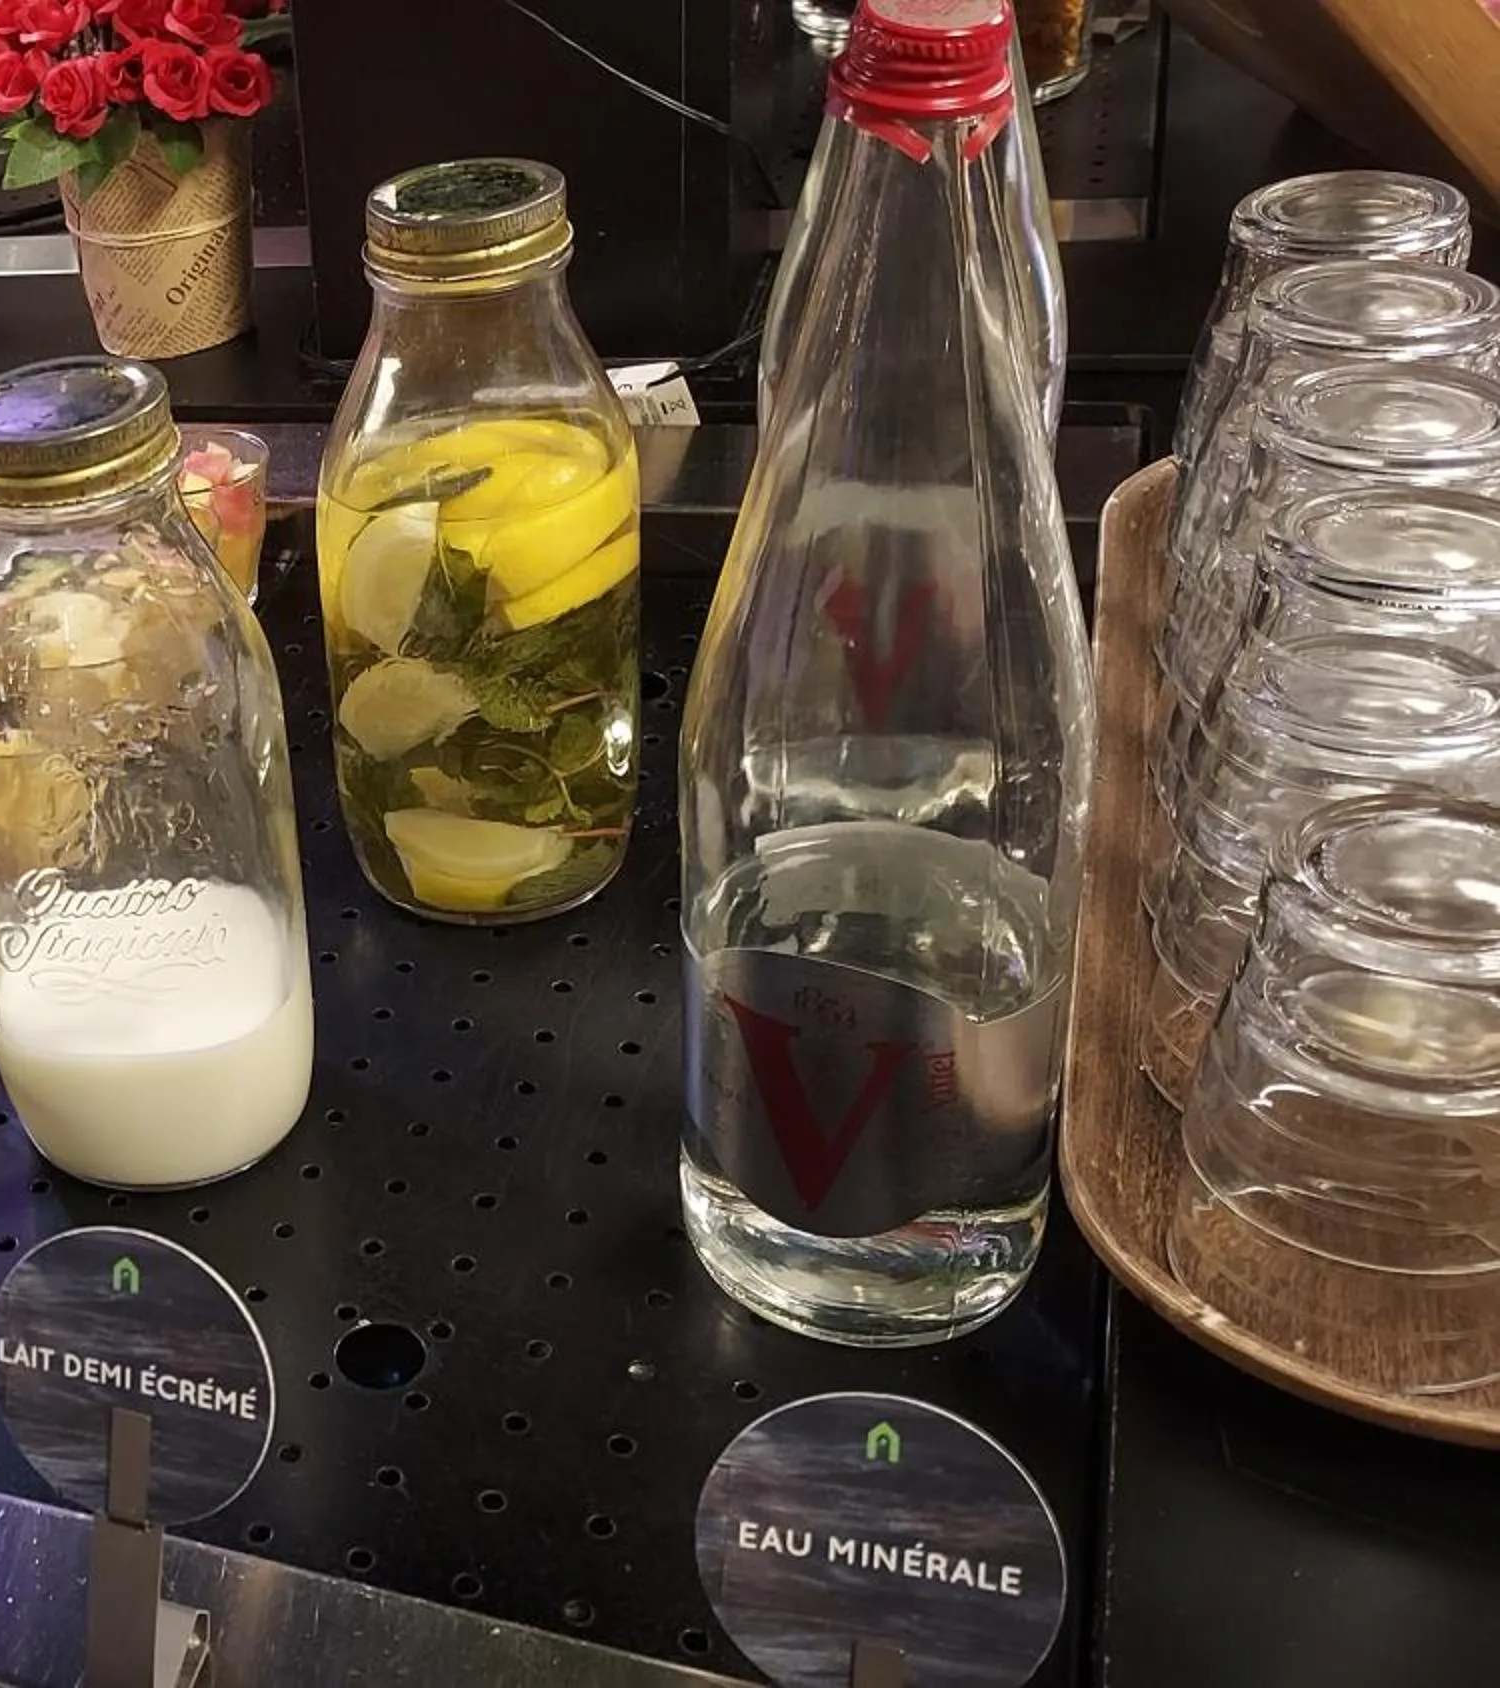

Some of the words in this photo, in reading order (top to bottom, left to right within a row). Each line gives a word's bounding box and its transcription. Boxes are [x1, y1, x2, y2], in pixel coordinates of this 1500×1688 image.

[722, 990, 920, 1213] V
[63, 1353, 132, 1391] DEMI
[139, 1364, 258, 1421] ÉCRÉMÉ
[738, 1520, 813, 1558] EAU
[827, 1542, 1024, 1597] MINÉRALE
